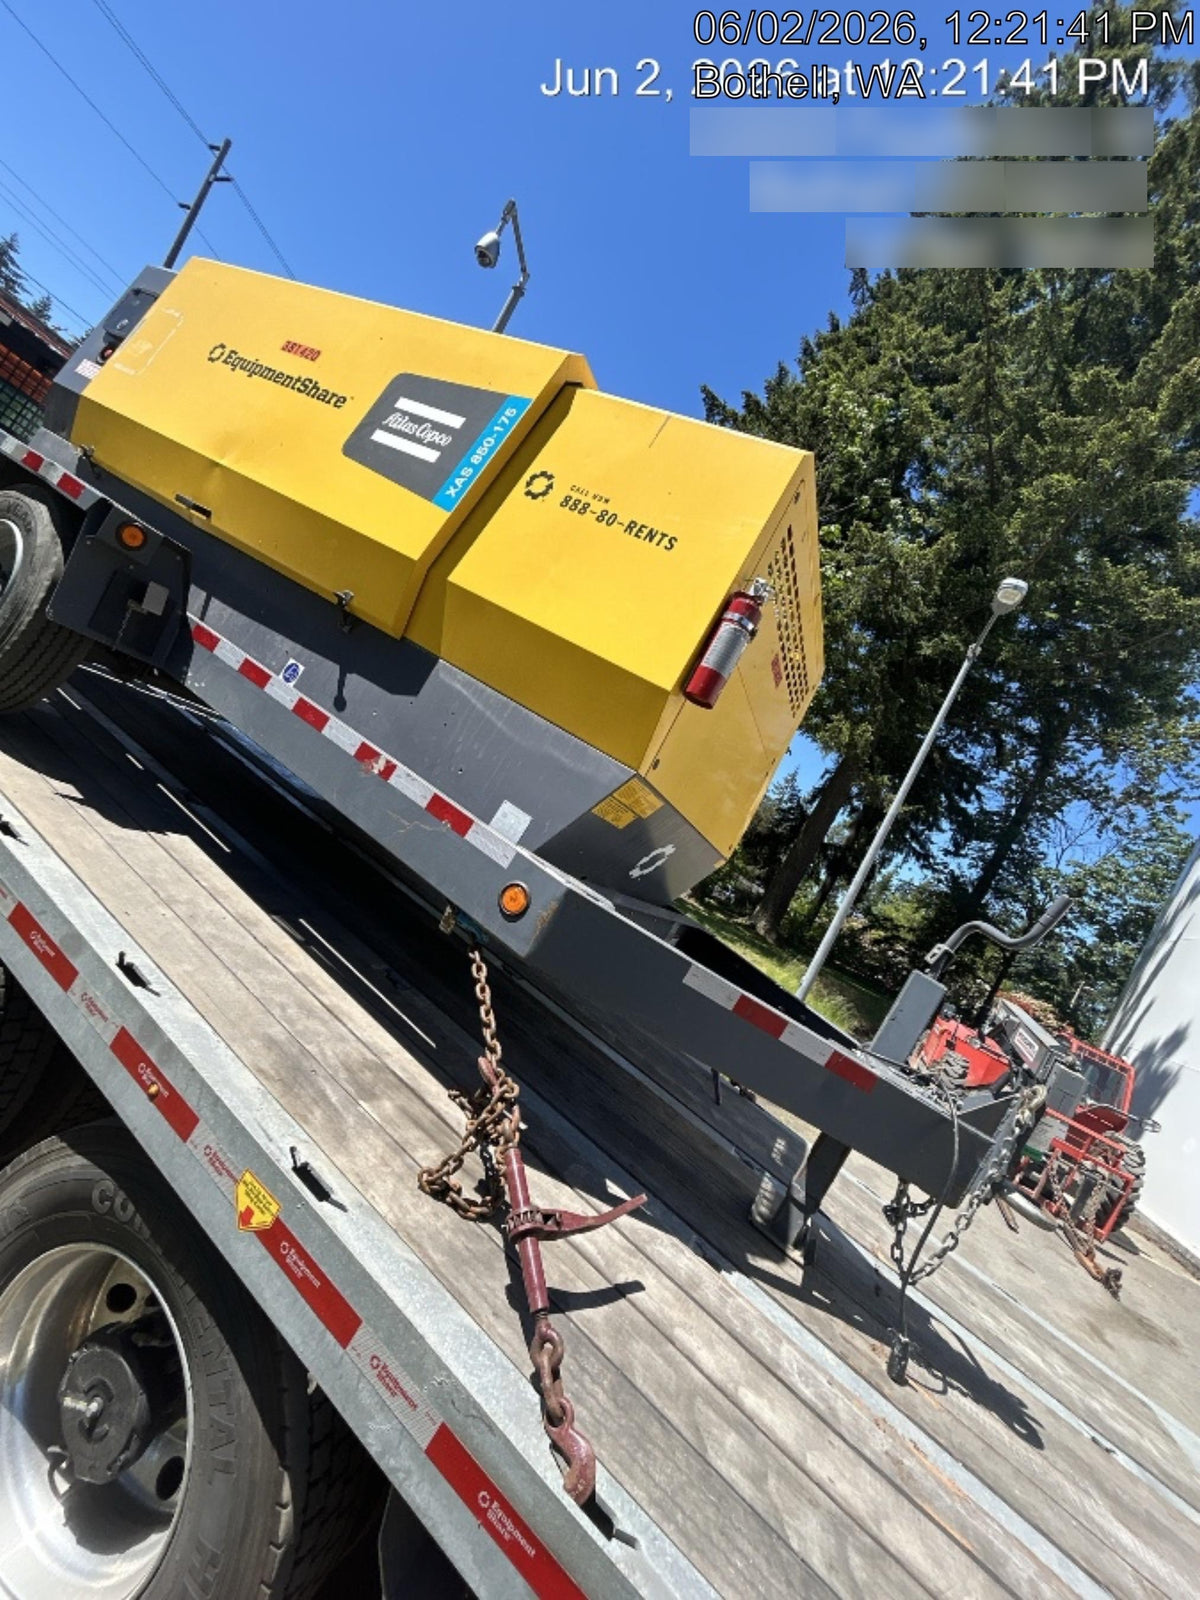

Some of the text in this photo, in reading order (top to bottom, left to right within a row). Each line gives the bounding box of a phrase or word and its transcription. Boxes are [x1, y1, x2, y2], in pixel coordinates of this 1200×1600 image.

[222, 349, 348, 409] EquipmentShare
[382, 412, 453, 447] Atlas Copco
[445, 467, 474, 498] XAS
[559, 495, 679, 551] 888-80-RENTS
